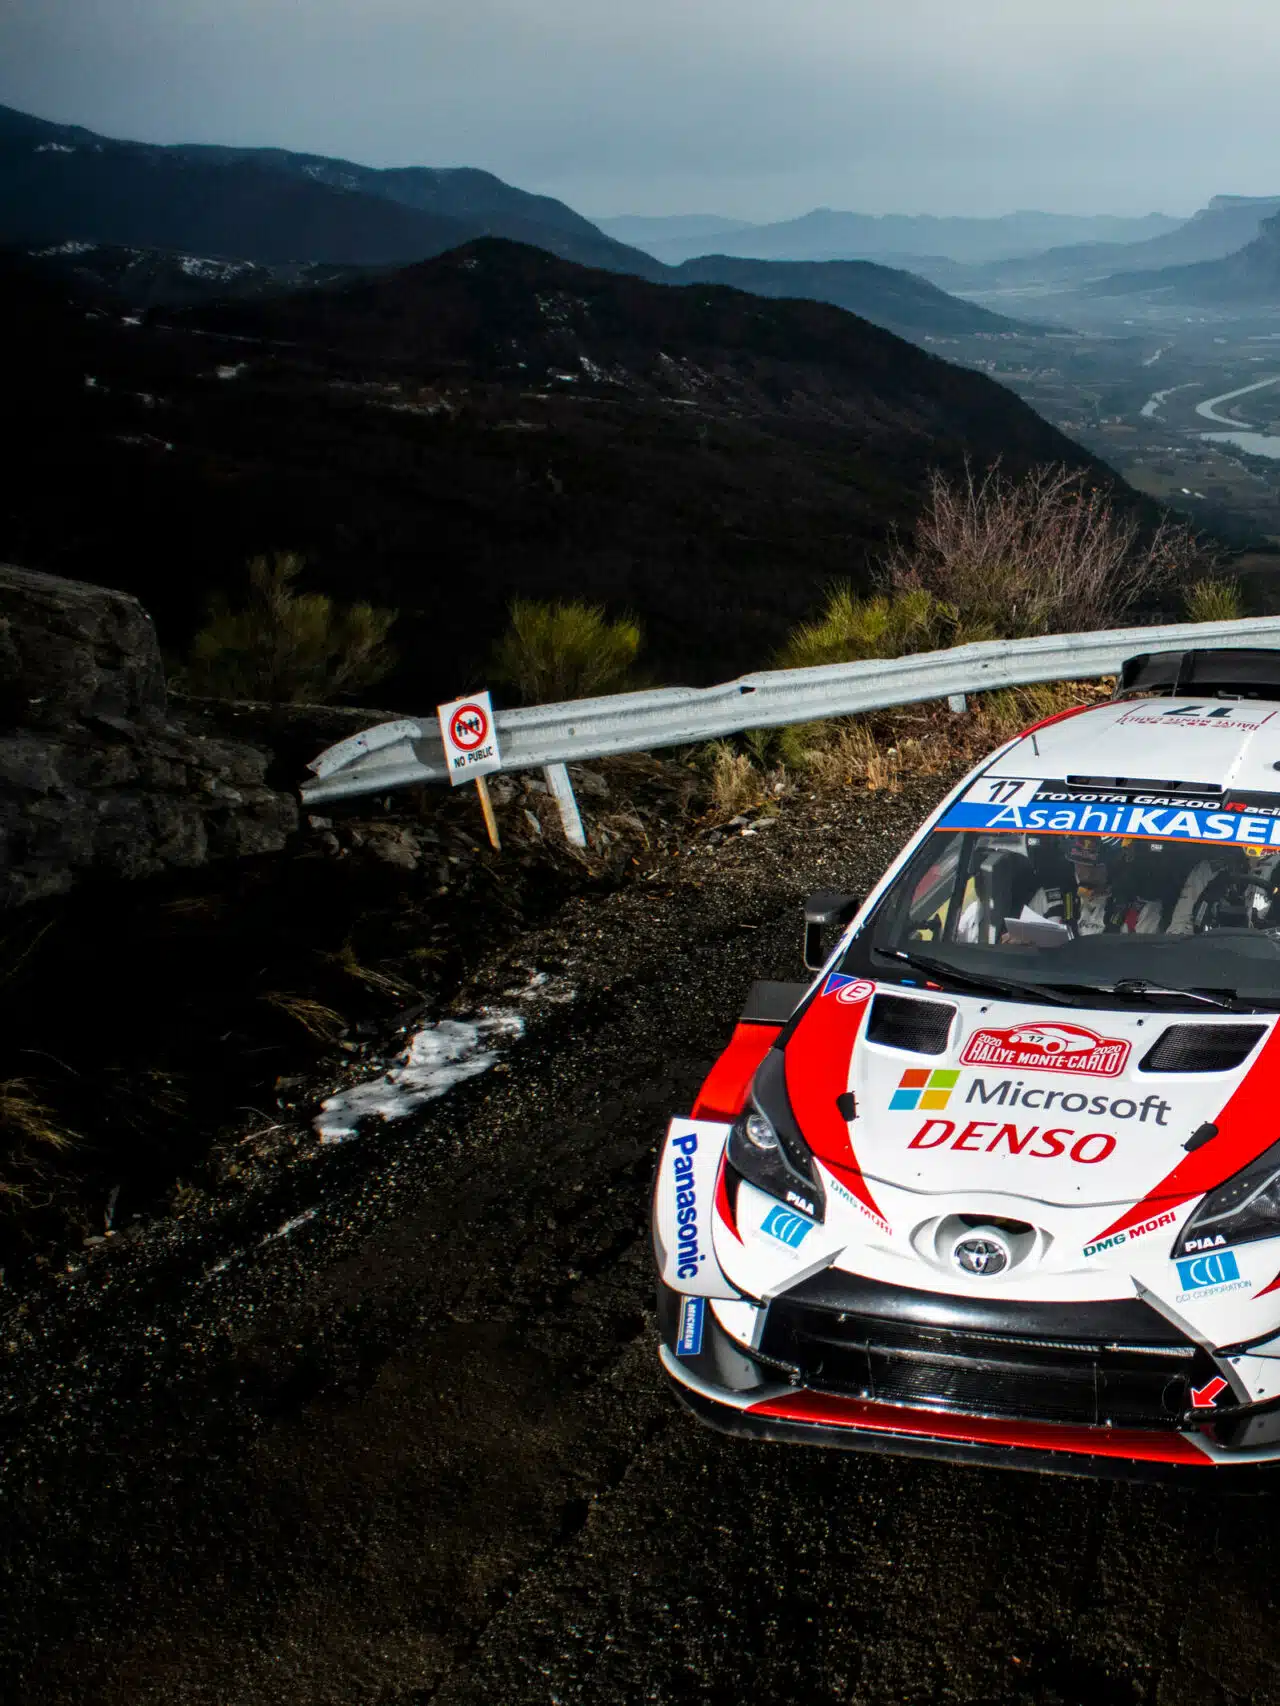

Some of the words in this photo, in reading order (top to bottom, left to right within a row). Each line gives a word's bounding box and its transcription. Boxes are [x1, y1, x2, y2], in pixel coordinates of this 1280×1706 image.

[1162, 705, 1235, 718] 17
[453, 756, 466, 768] NO
[468, 747, 493, 762] PUBLIC
[986, 780, 1024, 804] 17
[1035, 791, 1130, 805] TOYOTA
[1132, 795, 1222, 810] GAZOO
[846, 985, 867, 998] E
[978, 1033, 1002, 1046] 2020
[1028, 1035, 1044, 1043] 17
[1092, 1044, 1122, 1055] 2020
[967, 1041, 1016, 1063] RALLYE
[1017, 1052, 1120, 1072] MONTE-CARLO
[965, 1078, 1172, 1126] Microsoft
[908, 1119, 1117, 1164] DENSO
[672, 1132, 706, 1280] Panasonic
[786, 1191, 815, 1215] PIAA
[1083, 1233, 1126, 1257] DMG
[1128, 1211, 1177, 1239] MORI
[1185, 1235, 1227, 1252] PIAA
[1189, 1255, 1226, 1285] CCI
[1193, 1279, 1252, 1300] CORPORATION
[683, 1303, 696, 1350] MICHELIN
